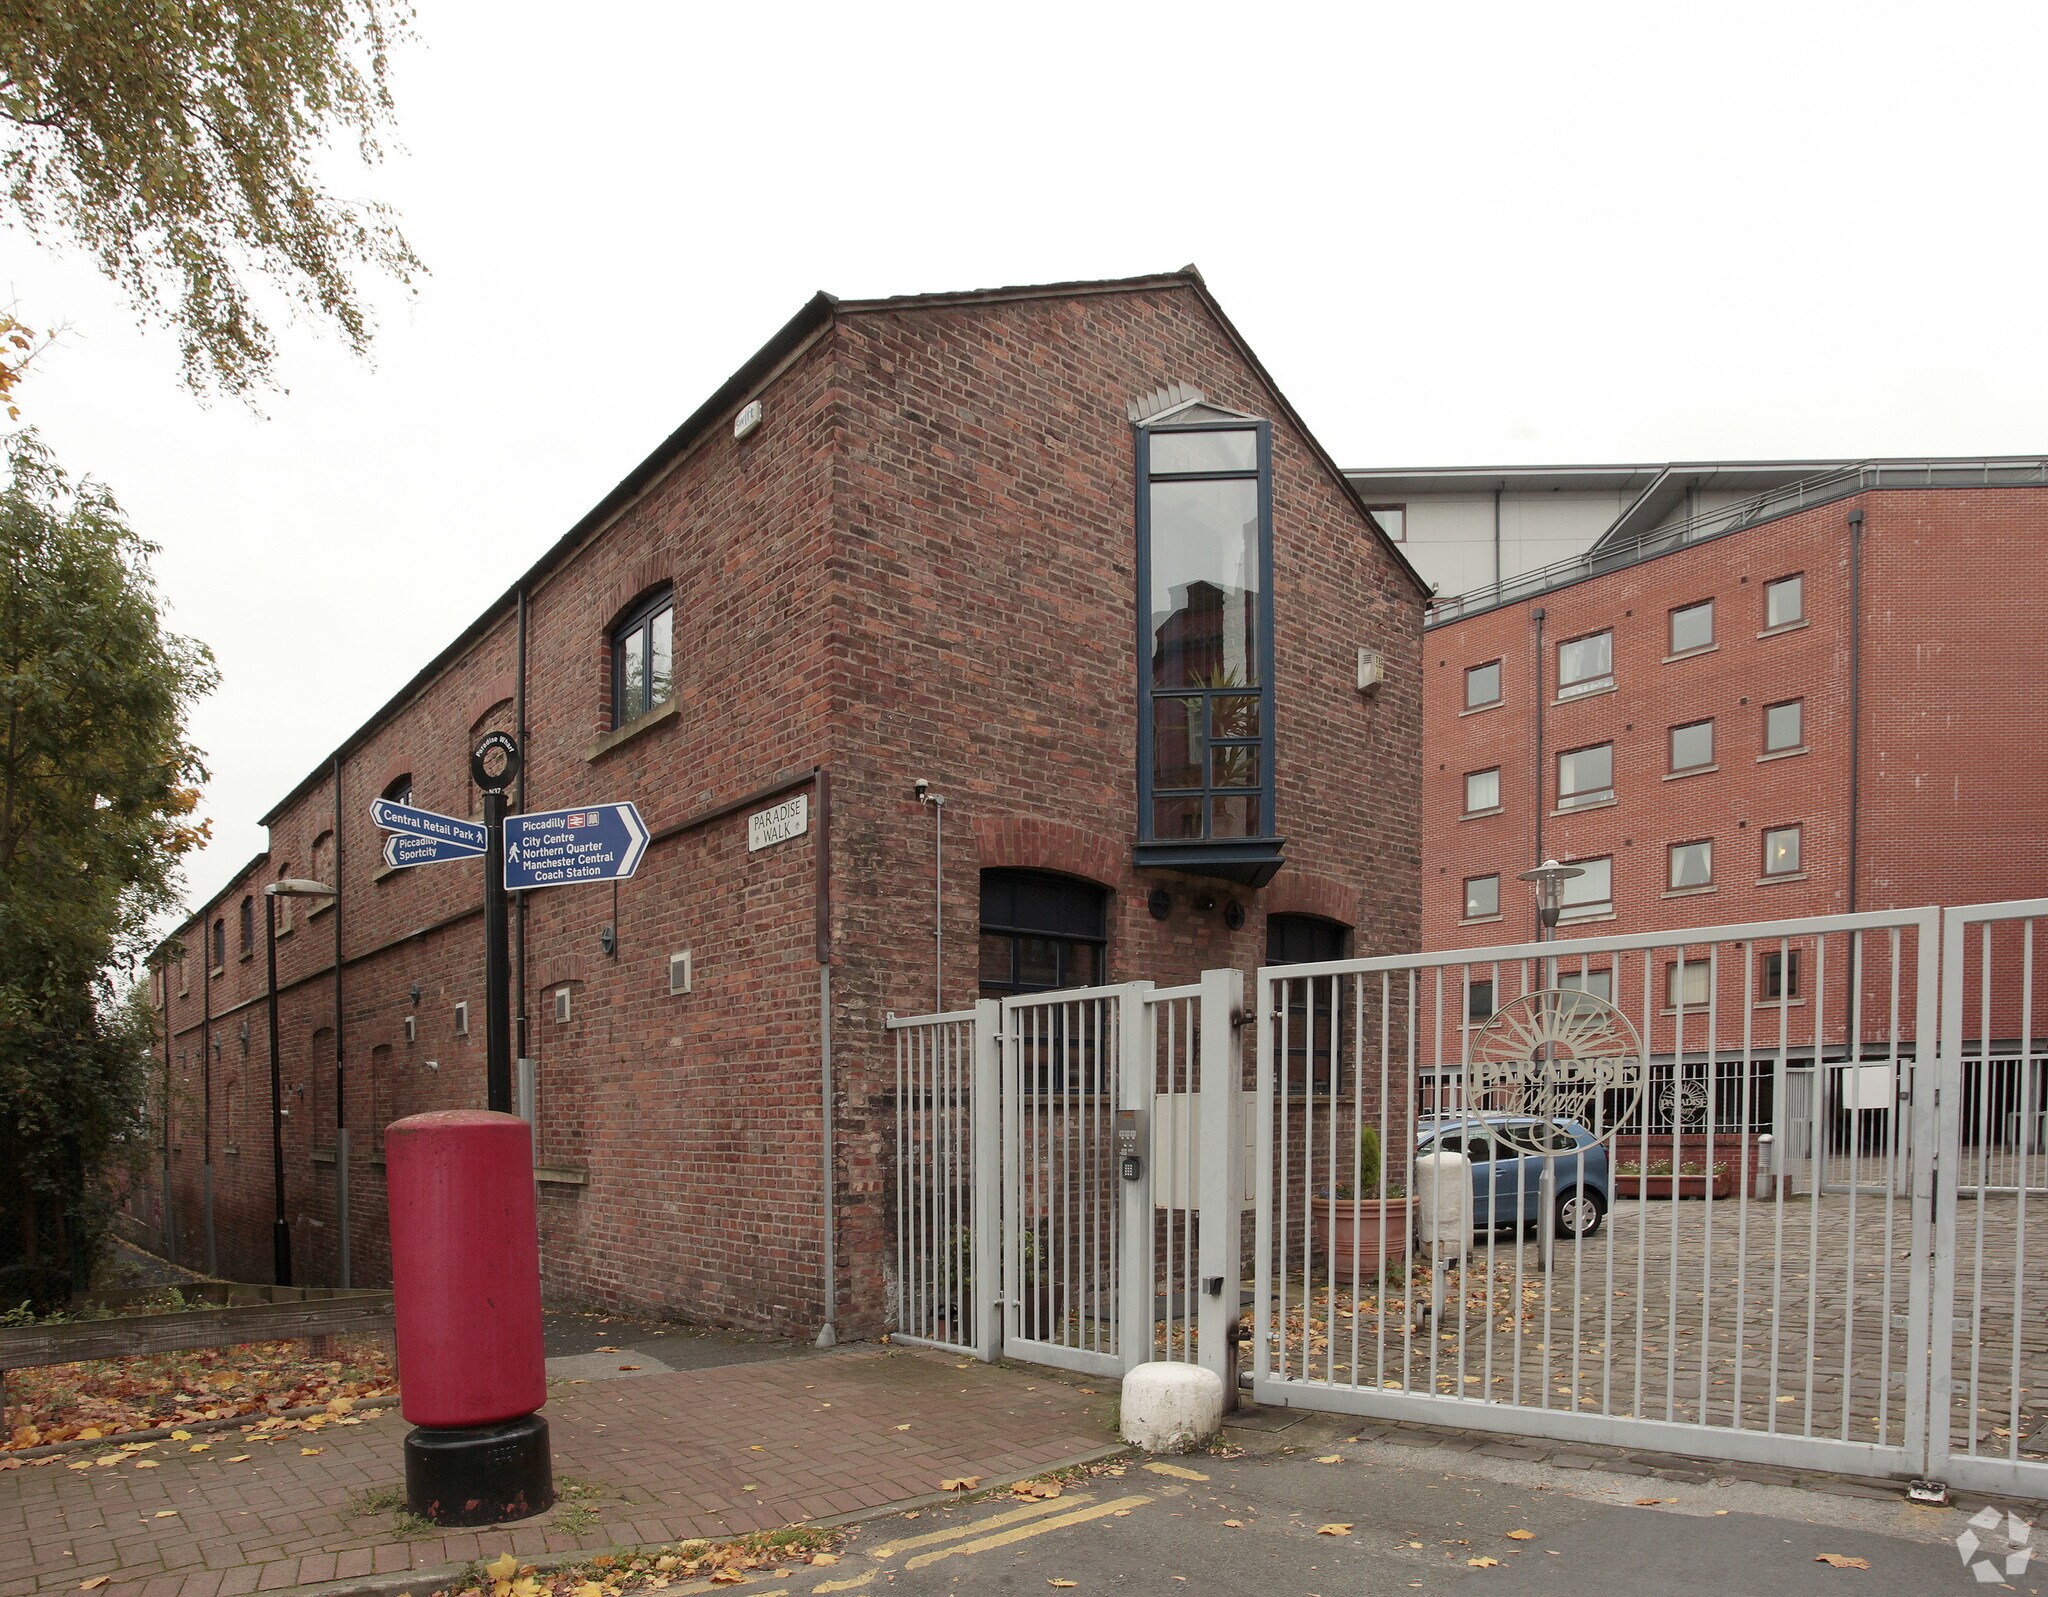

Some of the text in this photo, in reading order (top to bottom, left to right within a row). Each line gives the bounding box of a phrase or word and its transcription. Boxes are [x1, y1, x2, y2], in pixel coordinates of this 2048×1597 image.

[475, 735, 515, 758] Paradise Wharf
[754, 799, 801, 831] PARADISE
[384, 810, 474, 841] Central Retail Park
[522, 818, 566, 831] Piccadilly
[763, 820, 791, 843] WALK
[522, 833, 575, 848] City Centre
[399, 847, 438, 861] Sportcity
[523, 842, 603, 859] Northern Quarter
[523, 852, 614, 871] Manchester Central
[535, 866, 601, 881] Coach Station
[1471, 1057, 1640, 1094] PARADISE
[1661, 1098, 1708, 1109] PAADISE
